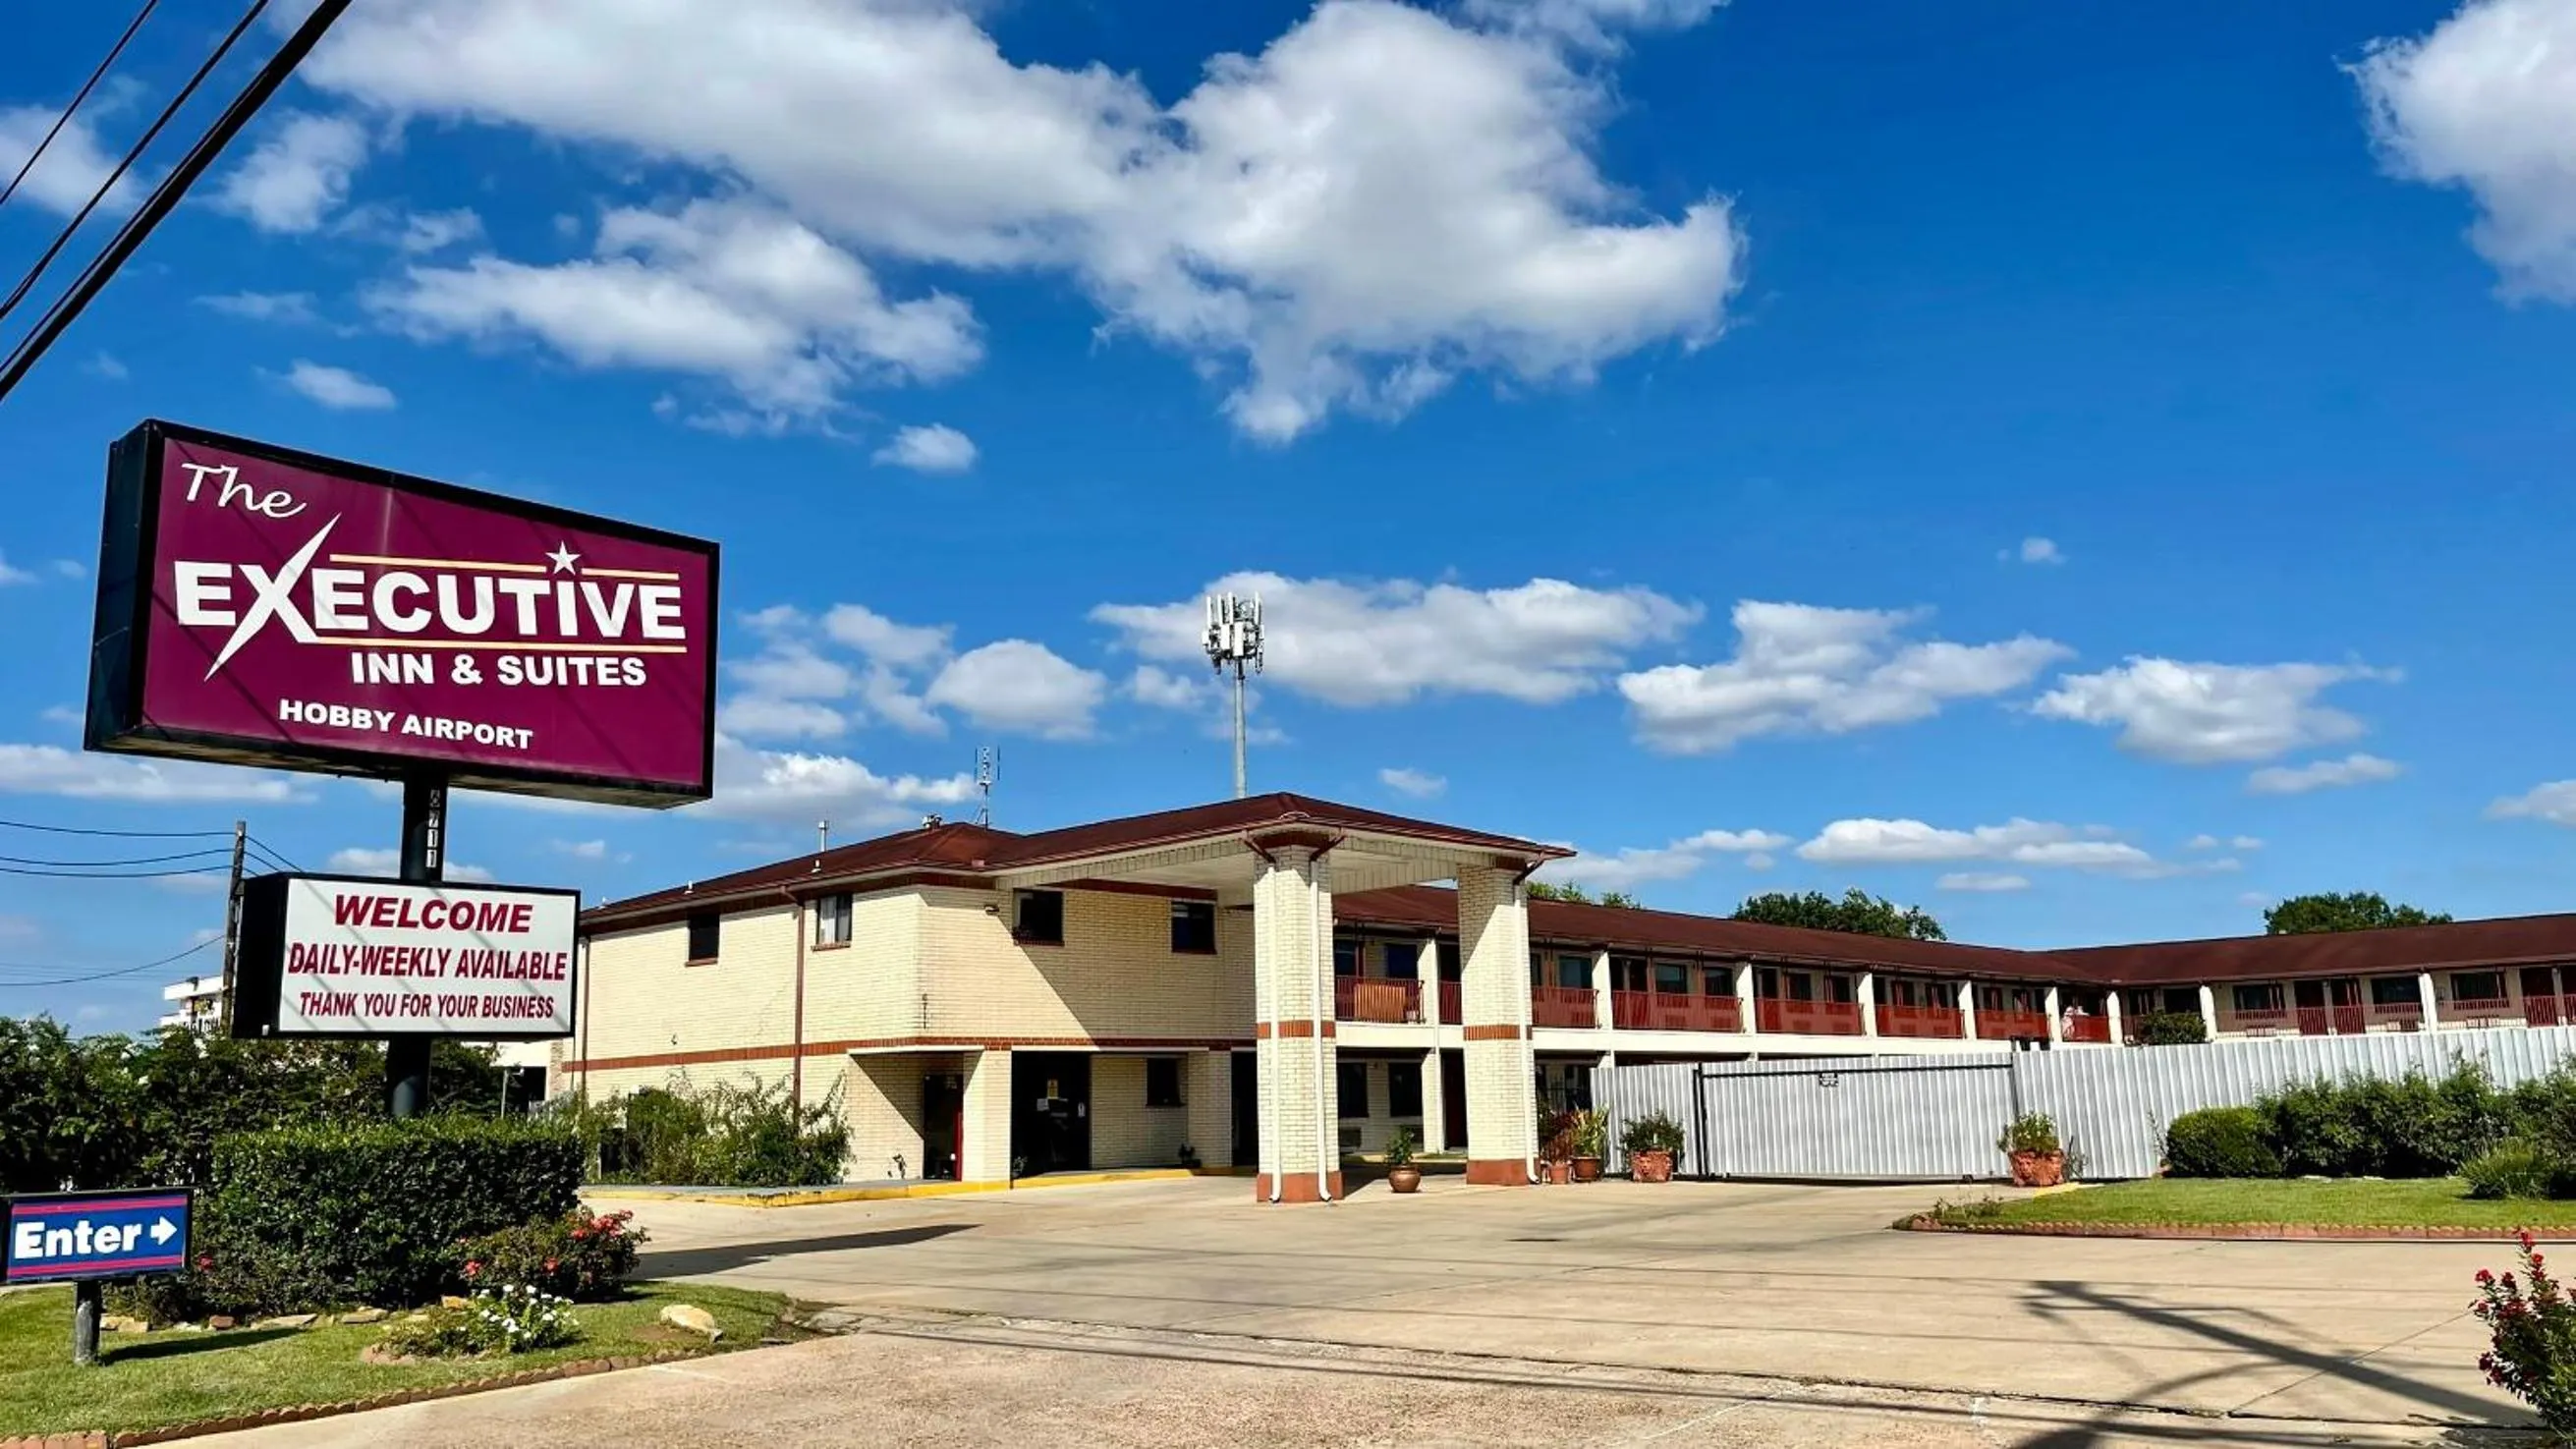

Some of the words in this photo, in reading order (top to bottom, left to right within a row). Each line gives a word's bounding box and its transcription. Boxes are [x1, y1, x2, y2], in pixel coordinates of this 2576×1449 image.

[181, 463, 307, 519] The
[174, 512, 687, 682] EXECUTIVE
[351, 651, 434, 685] INN
[450, 653, 483, 685] &
[497, 654, 646, 687] SUITES
[279, 698, 396, 733] HOBBY
[401, 713, 533, 751] AIRPORT
[335, 894, 533, 933] WELCOME
[287, 942, 452, 978] DAILY-WEEKLY
[454, 948, 568, 981] AVAILABLE
[300, 991, 359, 1018] THANK
[364, 993, 397, 1018] YOU
[399, 993, 432, 1018] FOR
[437, 994, 478, 1019] YOUR
[480, 995, 555, 1019] BUSINESS
[14, 1220, 142, 1259] Enter
